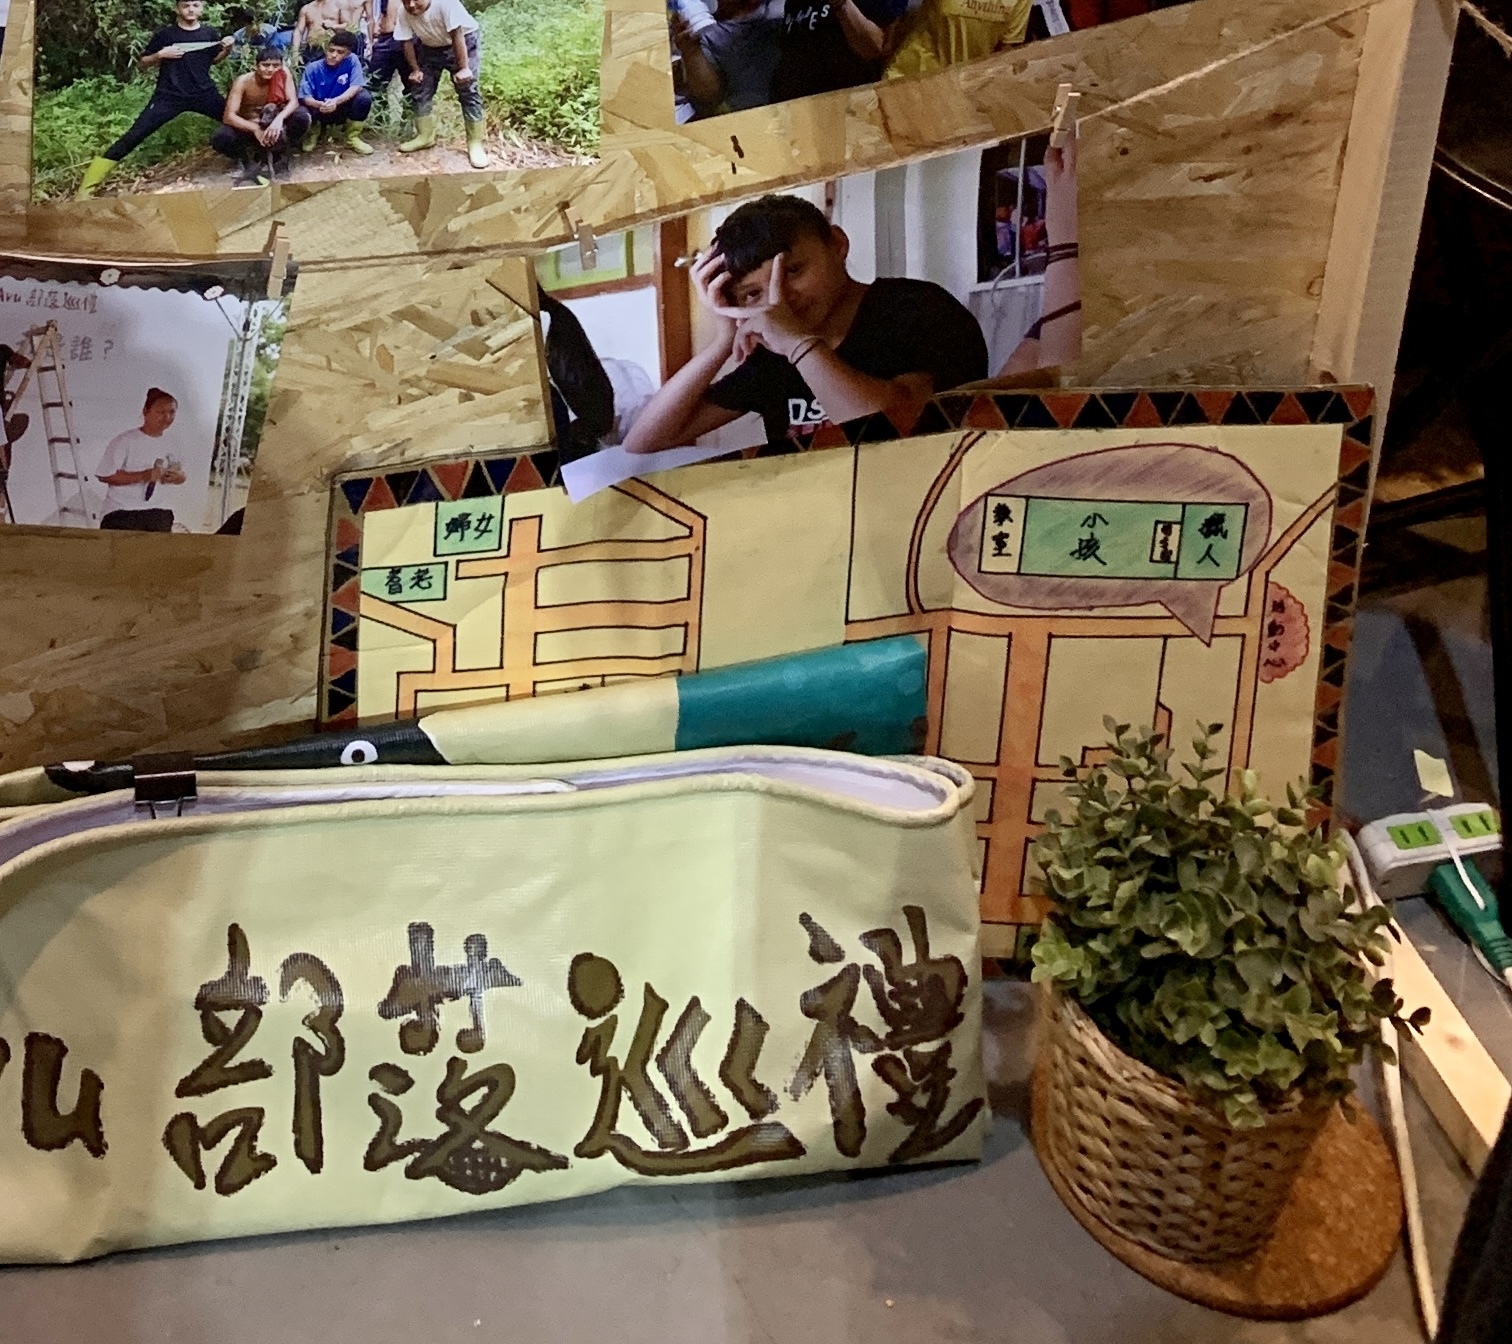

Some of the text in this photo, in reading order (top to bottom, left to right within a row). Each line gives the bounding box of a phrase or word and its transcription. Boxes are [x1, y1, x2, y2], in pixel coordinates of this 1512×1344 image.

[443, 512, 495, 542] 婦女
[1069, 512, 1109, 565] 小孩
[1196, 512, 1228, 567] 獵人
[163, 905, 987, 1197] 部落巡禮
